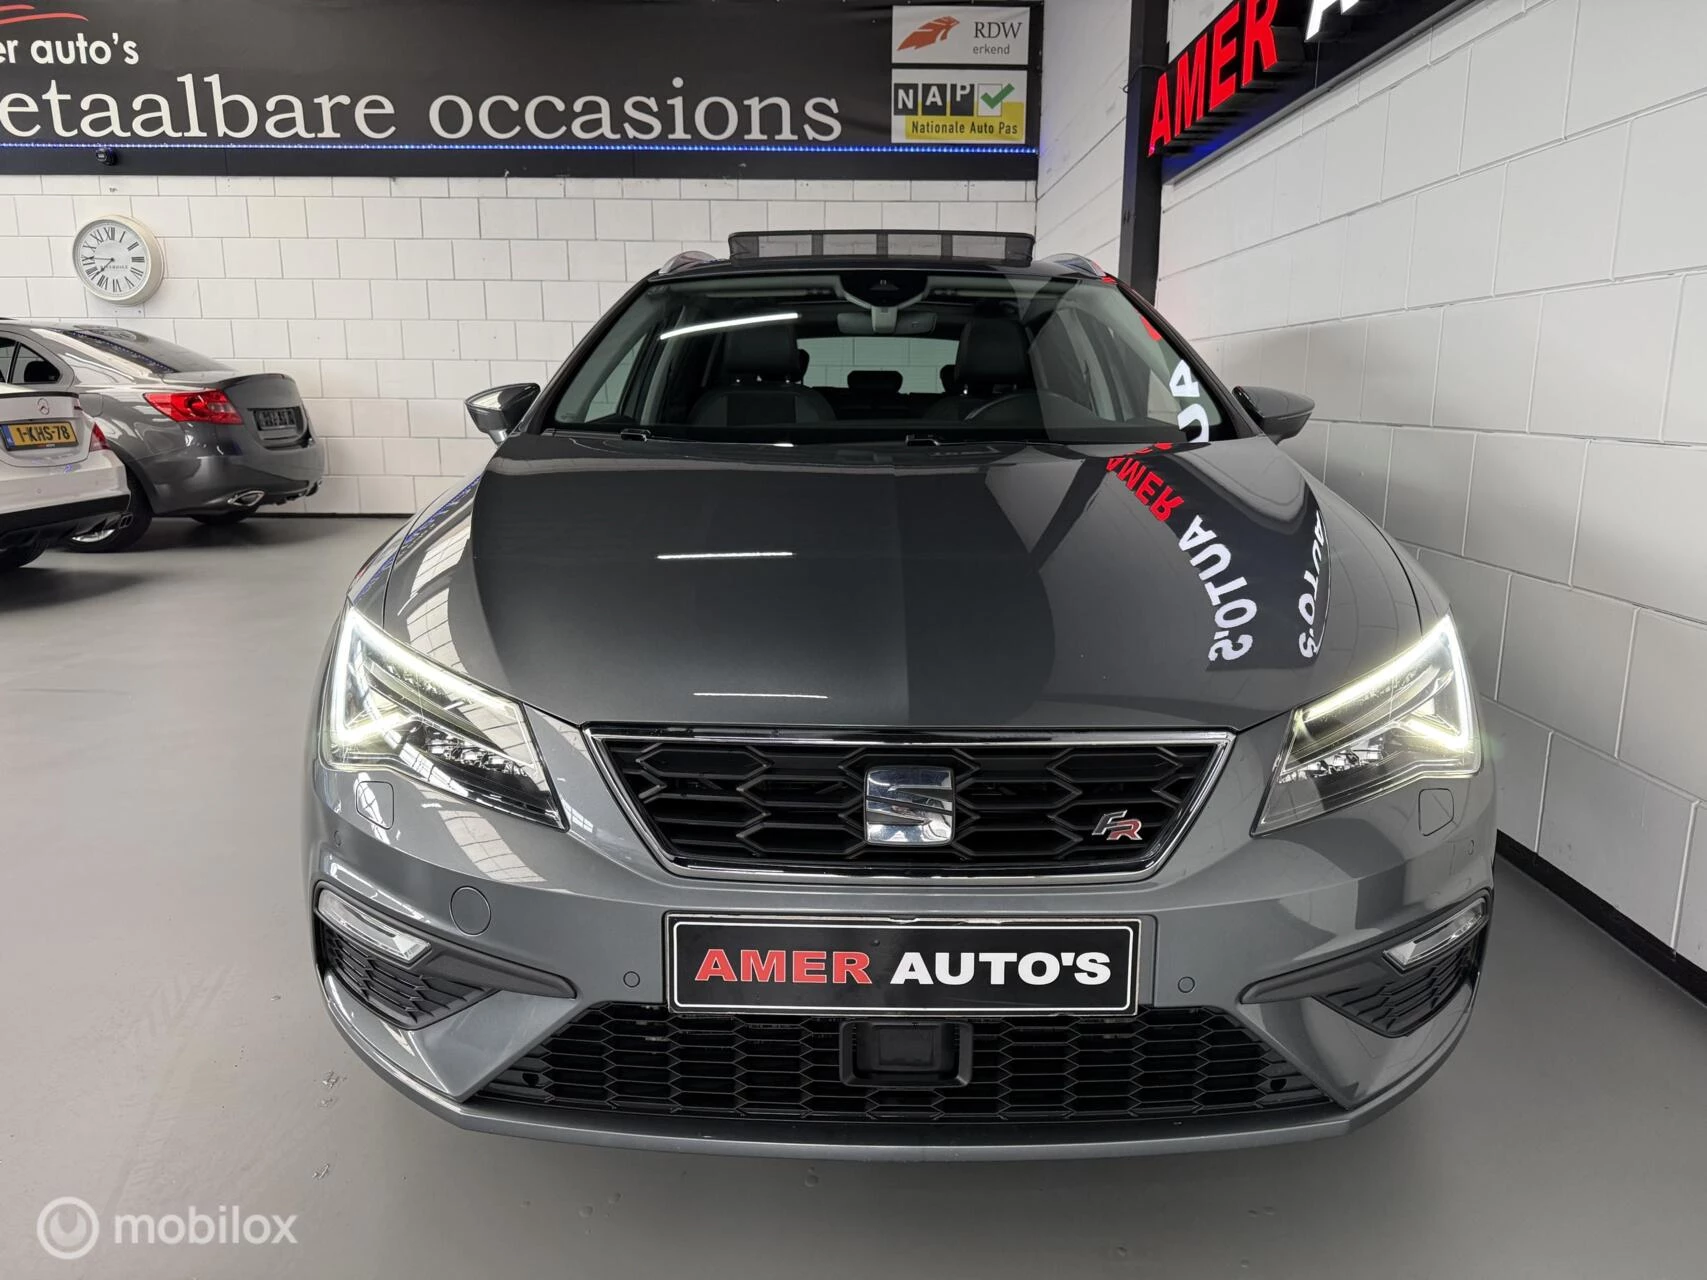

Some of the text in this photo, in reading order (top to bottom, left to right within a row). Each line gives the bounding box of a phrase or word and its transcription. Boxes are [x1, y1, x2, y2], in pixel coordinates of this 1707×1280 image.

[974, 22, 1022, 39] RDW
[30, 32, 139, 65] auto's
[973, 44, 1010, 54] erkend
[1148, 0, 1278, 156] AMER
[429, 77, 842, 140] occasions
[912, 121, 1018, 134] Nationale Auto Pas
[17, 425, 70, 442] 1-KHS-78
[1092, 809, 1142, 840] FR
[694, 948, 1111, 986] AMER AUTO'S
